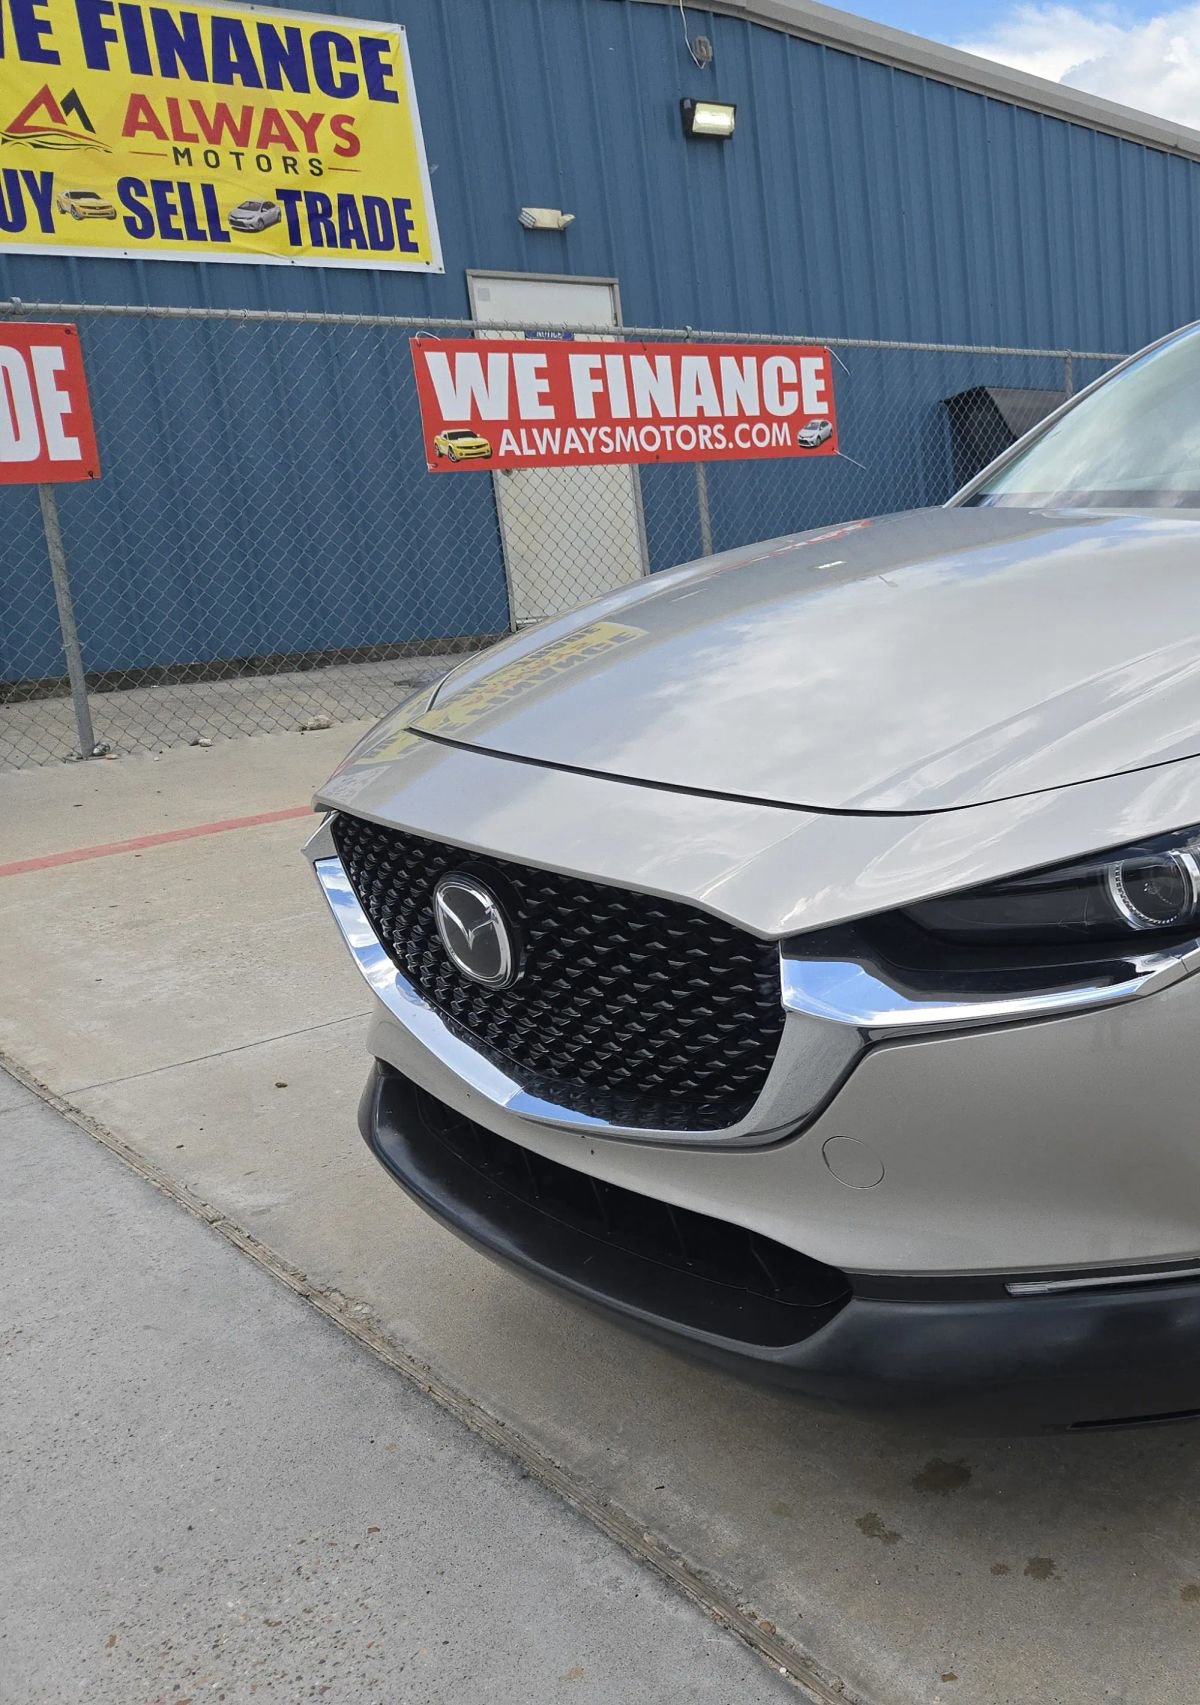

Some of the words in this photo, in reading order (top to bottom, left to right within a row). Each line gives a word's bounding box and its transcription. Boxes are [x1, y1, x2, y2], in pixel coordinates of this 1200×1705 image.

[0, 0, 61, 66] E
[75, 0, 399, 104] FINANCE
[122, 93, 361, 158] ALWAYS
[173, 146, 324, 177] MOTORS
[0, 168, 55, 233] UY
[117, 176, 231, 243] SELL
[276, 188, 420, 254] TRADE
[0, 345, 82, 462] DE
[424, 351, 555, 421] WE
[568, 353, 829, 420] FINANCE
[498, 422, 792, 456] ALWAYSMOTORS.COM
